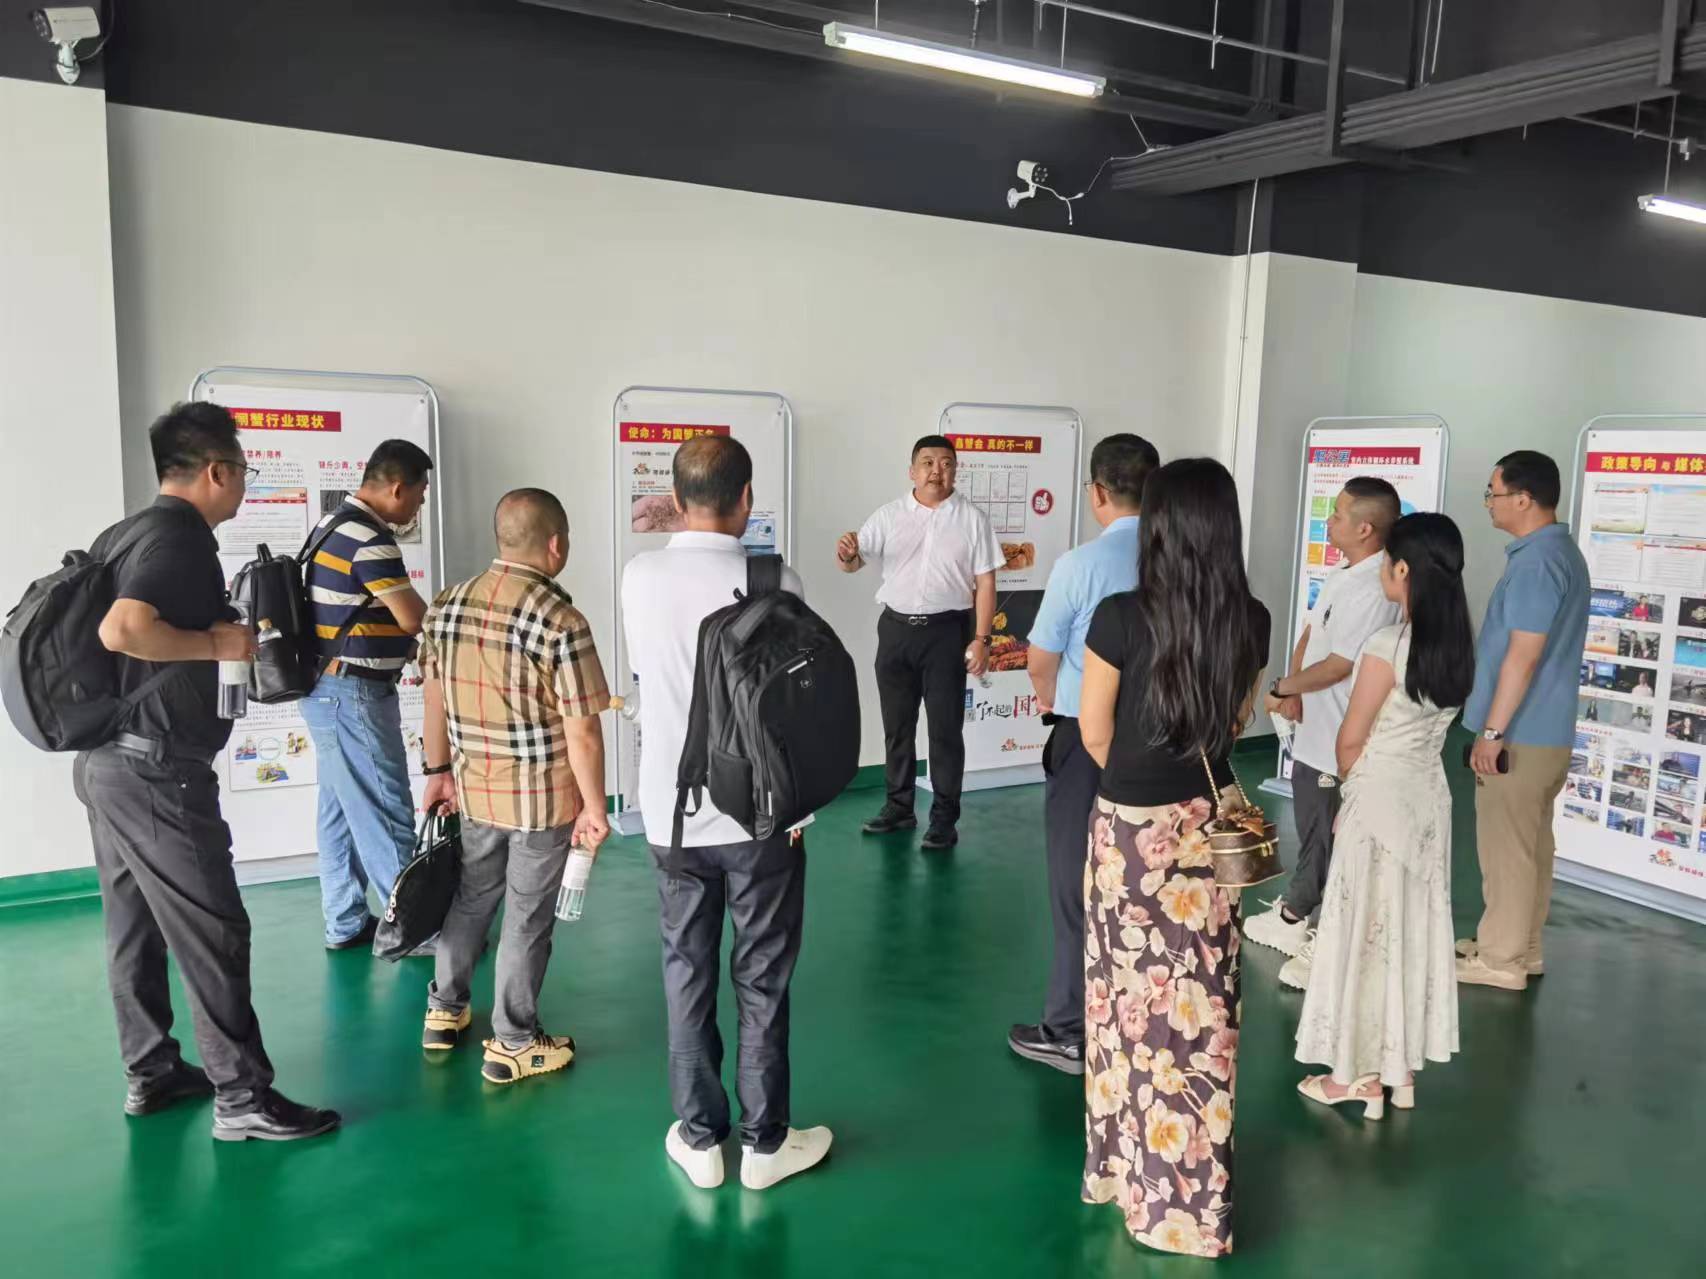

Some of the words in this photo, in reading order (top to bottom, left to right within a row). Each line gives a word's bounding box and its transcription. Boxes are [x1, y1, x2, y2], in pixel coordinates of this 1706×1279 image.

[1601, 456, 1657, 471] 政策导向
[1674, 457, 1706, 473] 媒体
